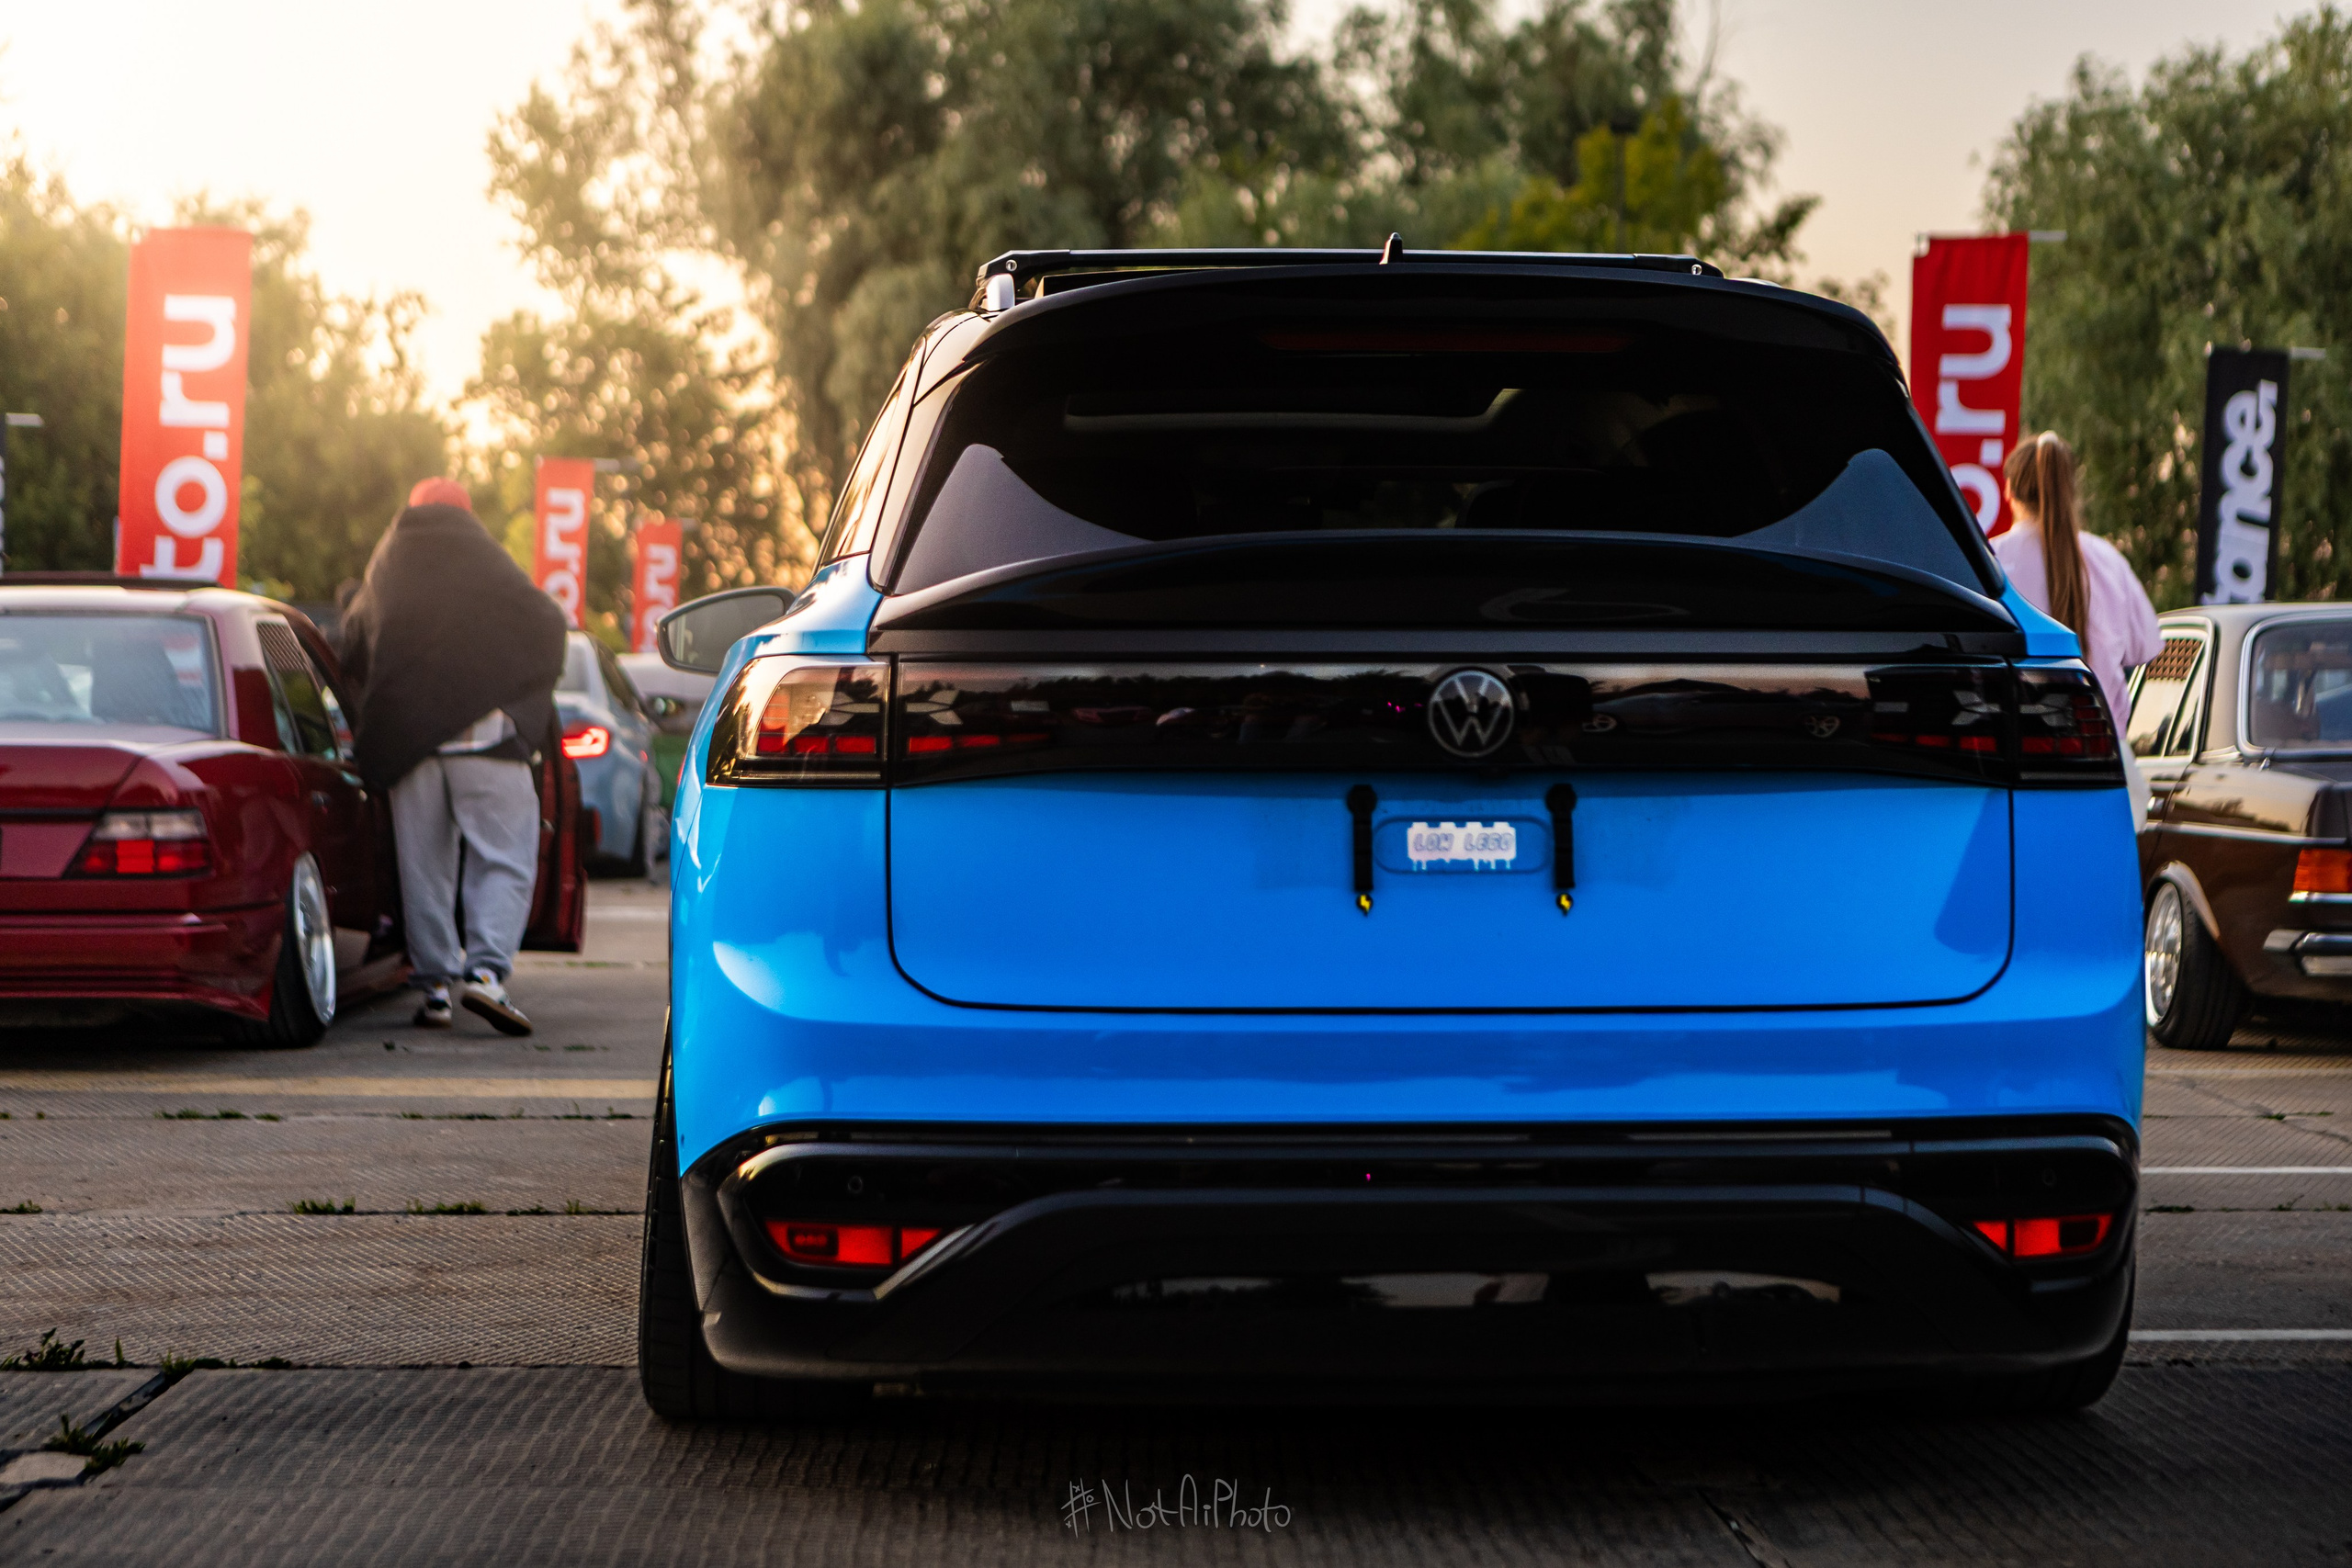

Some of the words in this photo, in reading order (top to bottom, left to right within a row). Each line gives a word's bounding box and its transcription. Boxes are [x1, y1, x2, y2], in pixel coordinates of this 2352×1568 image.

[140, 293, 236, 580] to.ru
[2201, 378, 2278, 604] ance.
[544, 487, 585, 629] o.ru
